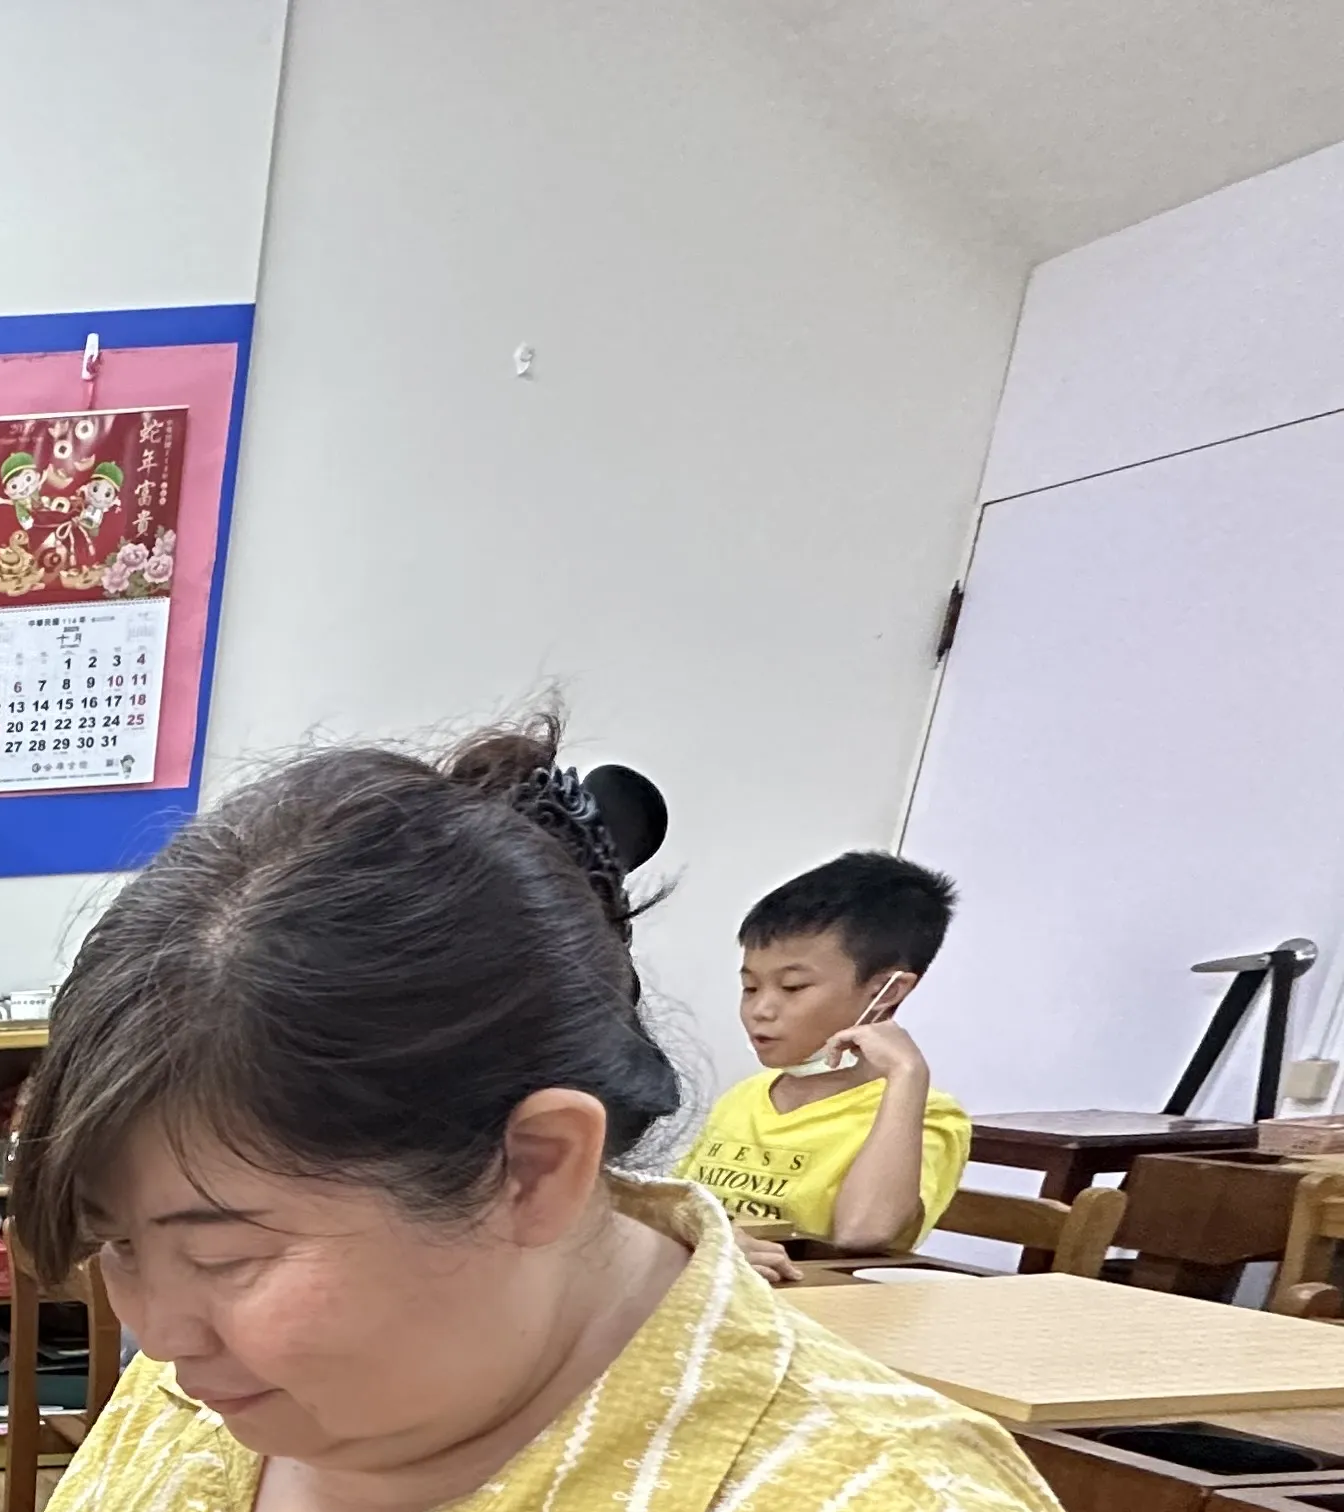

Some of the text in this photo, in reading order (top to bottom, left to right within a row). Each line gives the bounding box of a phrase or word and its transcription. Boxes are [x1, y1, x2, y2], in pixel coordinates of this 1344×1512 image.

[132, 419, 164, 537] 蛇年富貴
[64, 657, 72, 670] 1
[88, 656, 98, 669] 2
[112, 654, 122, 667] 3
[136, 653, 146, 665] 4
[13, 681, 23, 694] 6
[38, 679, 47, 692] 7
[61, 678, 71, 690] 8
[86, 676, 96, 689] 9
[107, 675, 124, 687] 10
[131, 673, 147, 686] 11
[8, 701, 25, 714] 13
[32, 699, 49, 712] 14
[56, 698, 74, 711] 15
[81, 696, 98, 709] 16
[105, 695, 123, 708] 17
[129, 693, 146, 706] 18
[6, 721, 24, 733] 20
[30, 719, 47, 732] 21
[54, 718, 72, 731] 22
[78, 716, 96, 729] 23
[102, 714, 121, 727] 24
[126, 714, 145, 726] 25
[4, 740, 23, 754] 27
[28, 739, 46, 752] 28
[52, 737, 71, 751] 29
[76, 736, 95, 749] 30
[100, 735, 118, 748] 31
[707, 1142, 805, 1171] HESS
